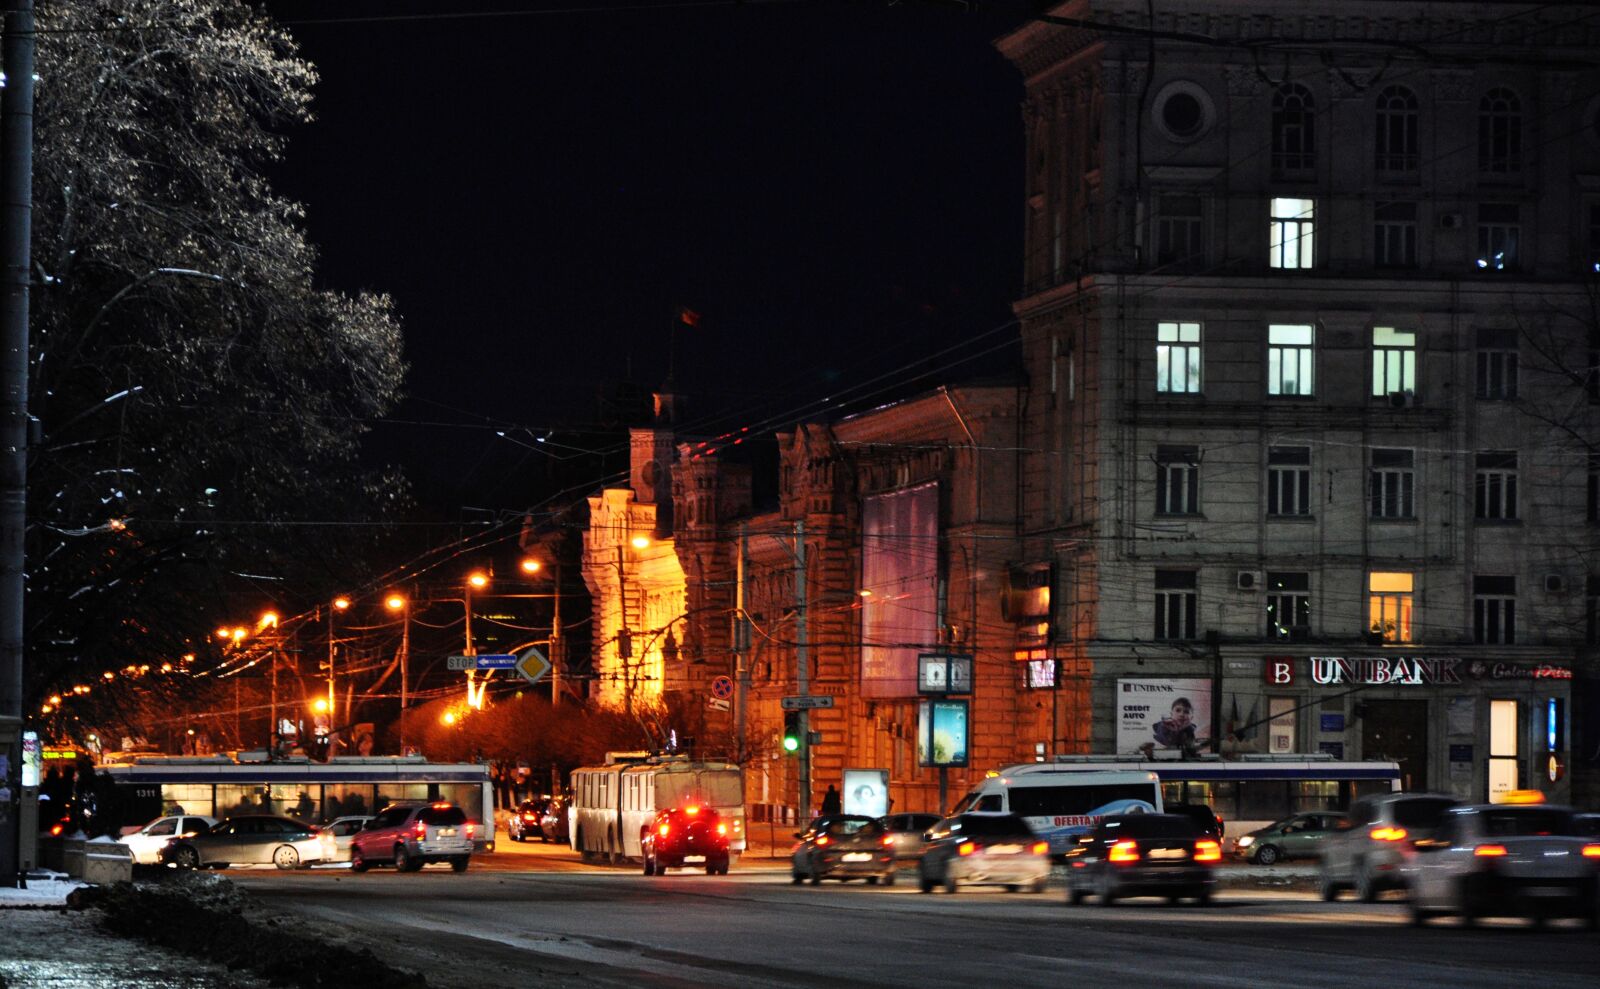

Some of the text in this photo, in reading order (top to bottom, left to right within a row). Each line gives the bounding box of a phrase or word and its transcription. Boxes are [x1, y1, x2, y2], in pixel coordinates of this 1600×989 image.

[448, 658, 474, 668] STOP
[1274, 663, 1291, 684] B
[1310, 656, 1462, 684] UNIBANK
[1133, 683, 1174, 692] UNIBANK
[136, 789, 155, 798] 1311
[1054, 815, 1091, 827] OFERTA
